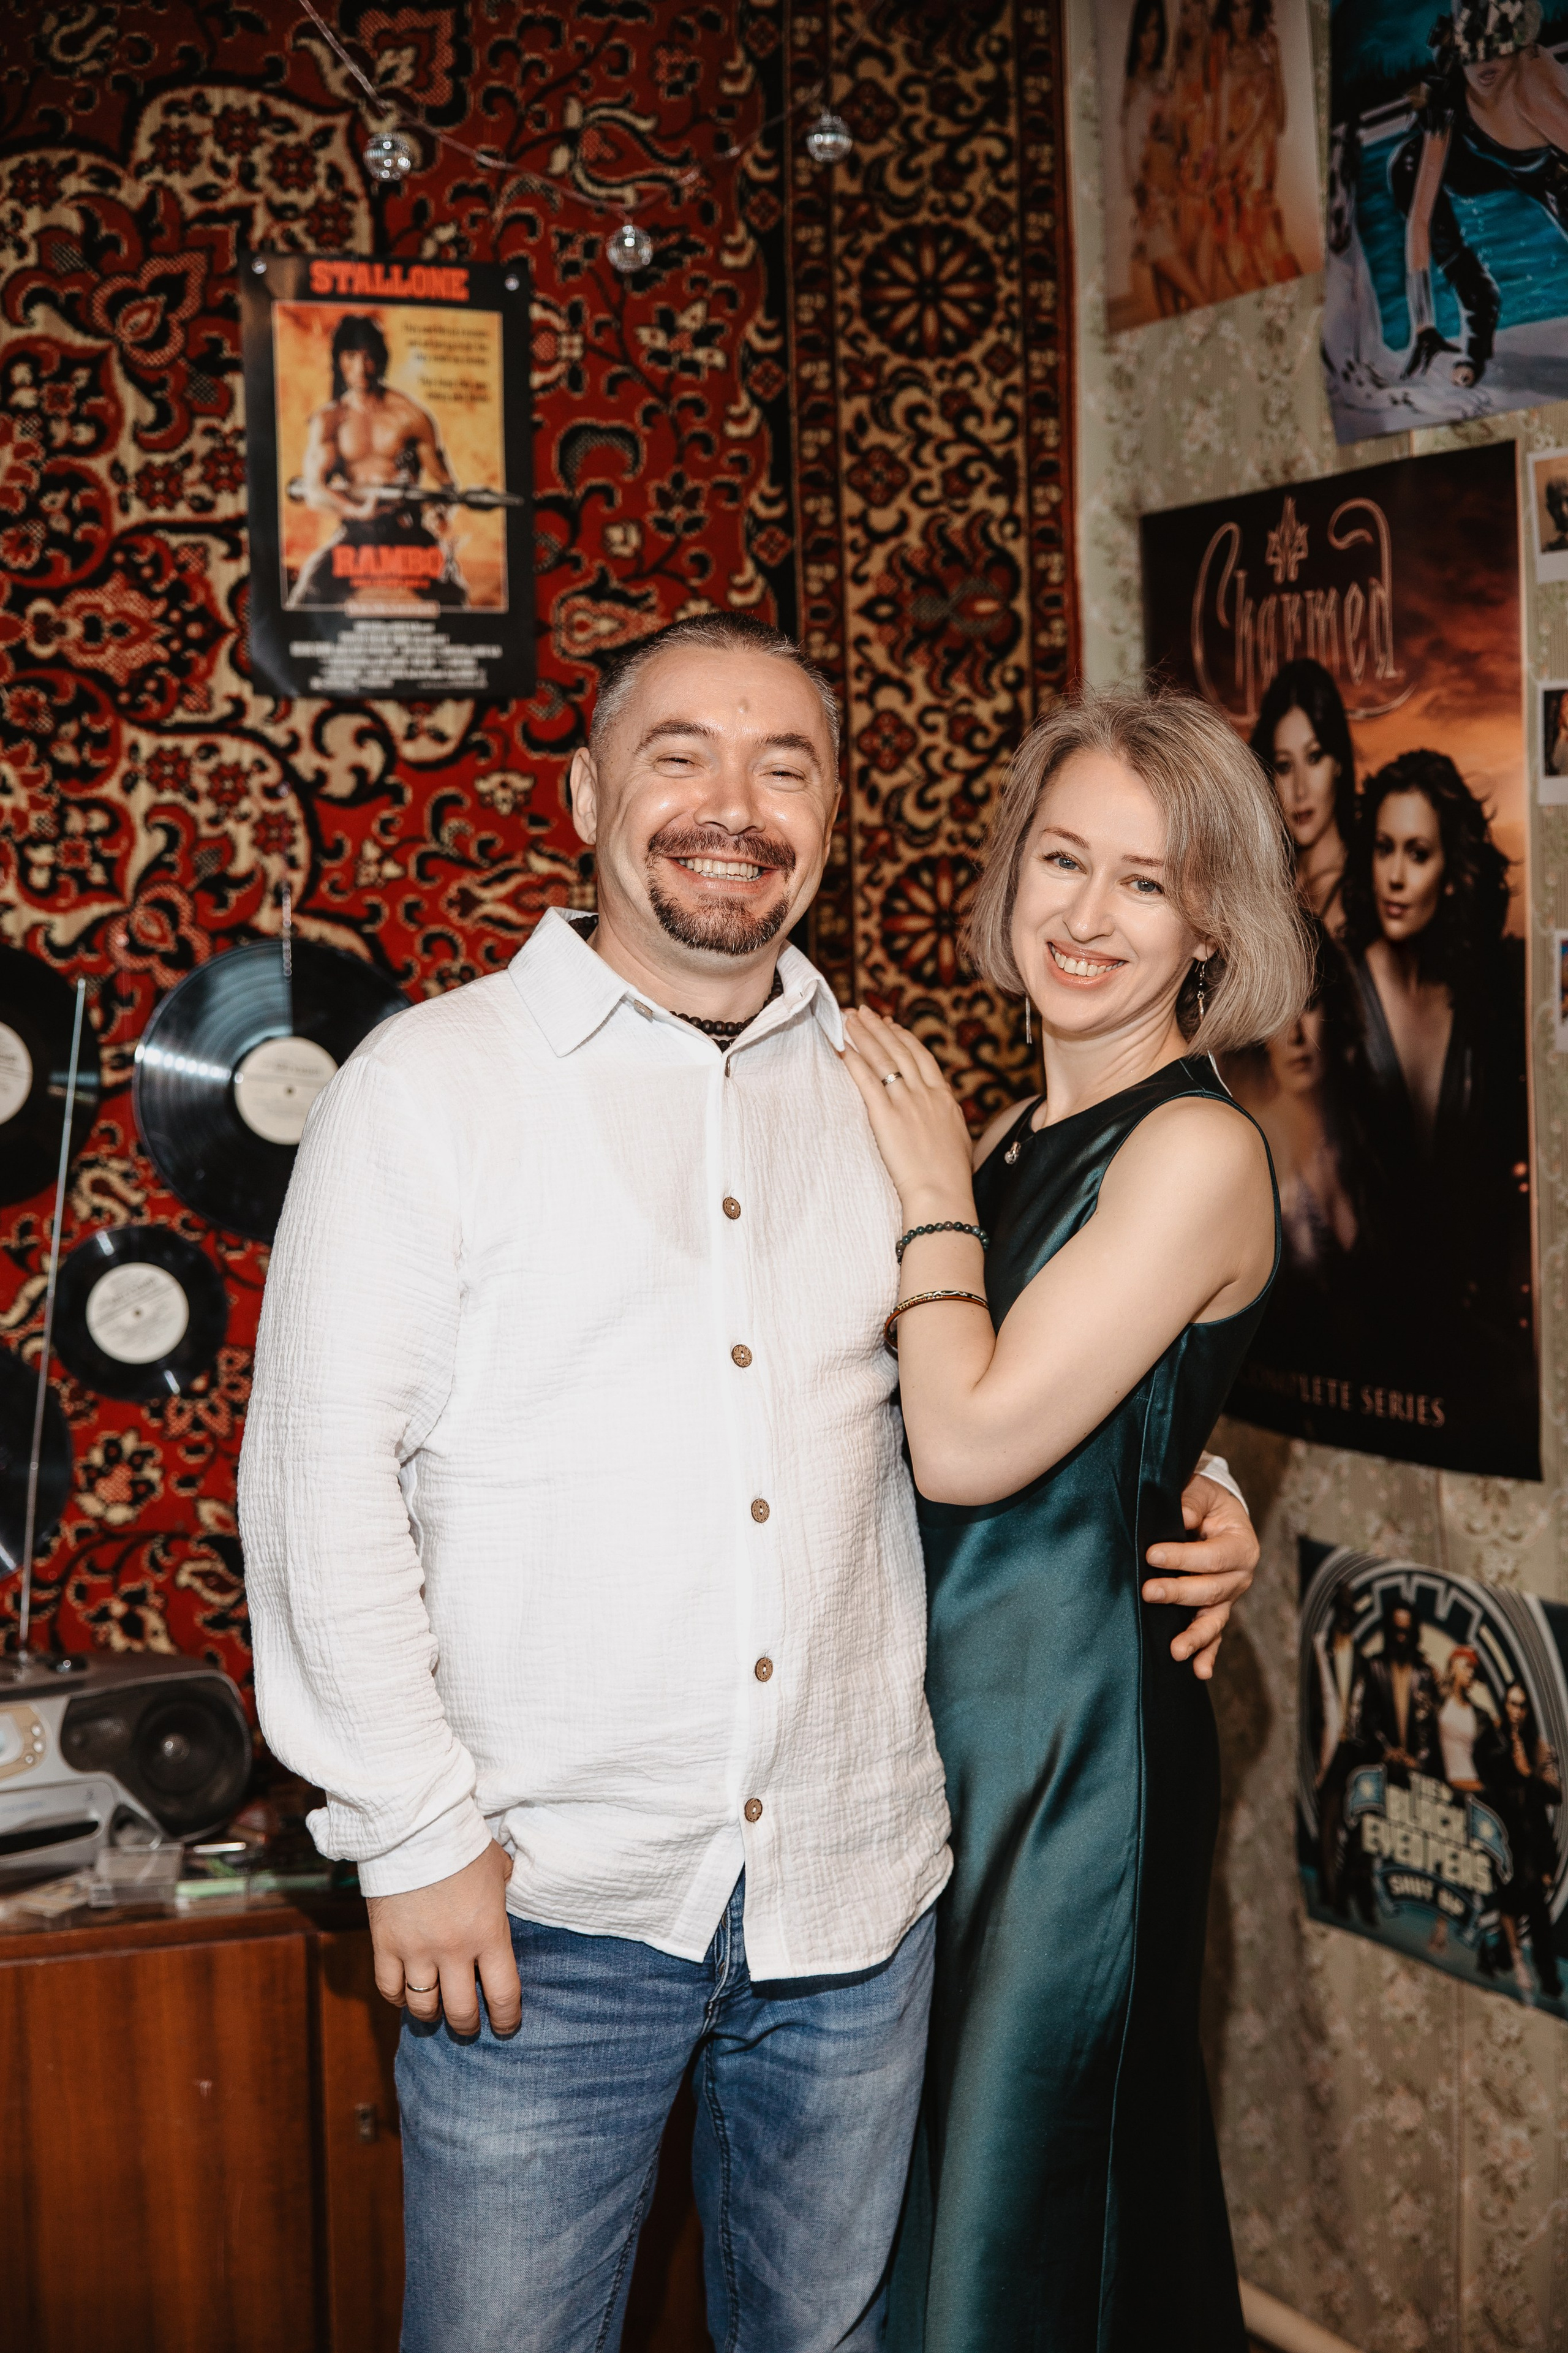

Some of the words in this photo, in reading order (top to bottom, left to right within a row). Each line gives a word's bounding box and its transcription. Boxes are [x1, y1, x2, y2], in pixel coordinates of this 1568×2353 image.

[309, 259, 470, 301] STALLONE
[331, 543, 445, 579] RAMBO
[1190, 497, 1415, 725] Charmed
[1359, 1384, 1446, 1428] SERIES
